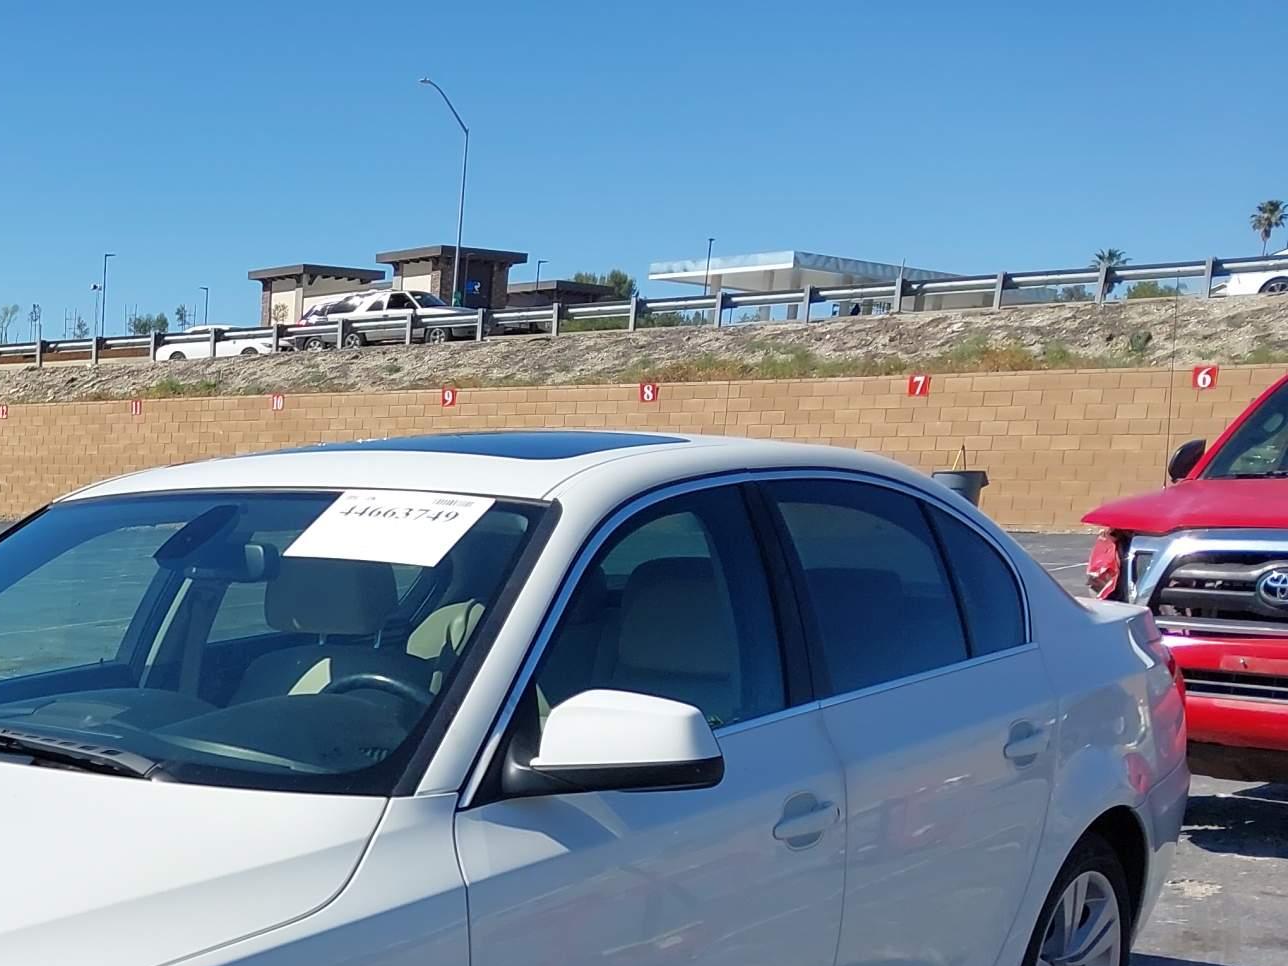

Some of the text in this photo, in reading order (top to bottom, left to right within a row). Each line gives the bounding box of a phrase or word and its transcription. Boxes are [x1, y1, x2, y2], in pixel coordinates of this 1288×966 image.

[912, 375, 925, 395] 7
[1197, 367, 1212, 389] 6
[444, 390, 453, 406] 9
[643, 384, 654, 401] 8
[132, 401, 140, 415] 11
[272, 395, 283, 410] 10
[0, 405, 7, 419] 12
[339, 504, 460, 522] 44663749
